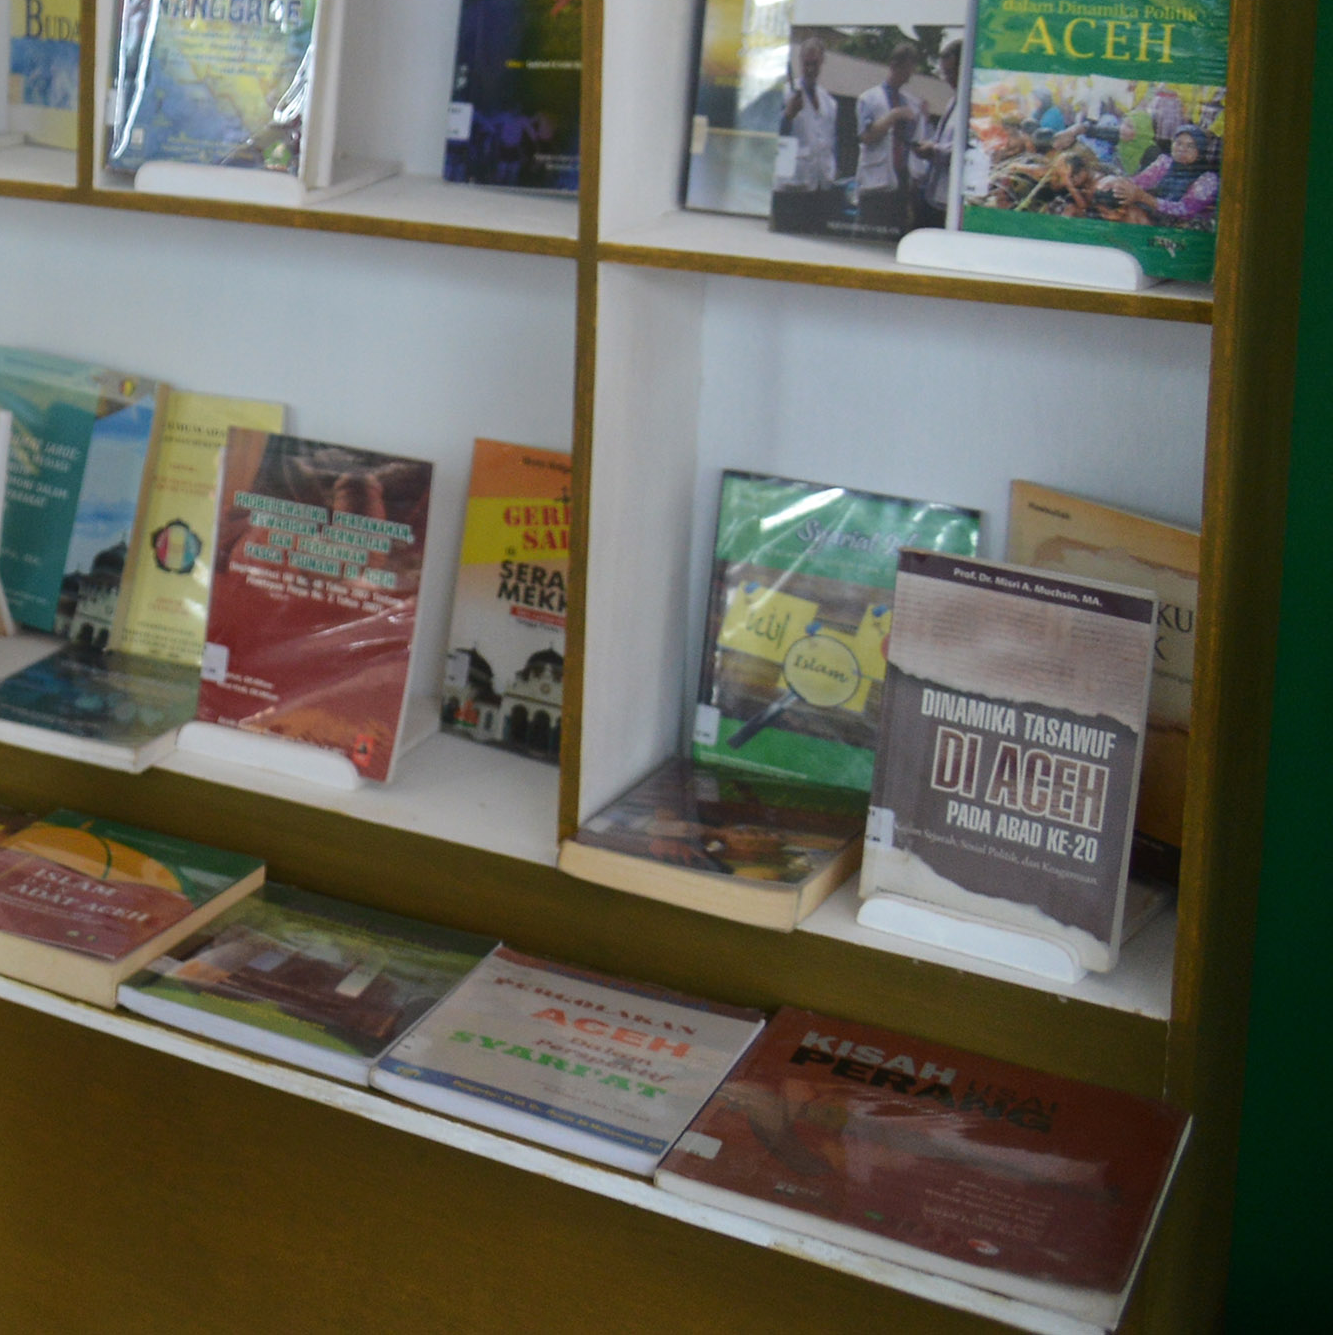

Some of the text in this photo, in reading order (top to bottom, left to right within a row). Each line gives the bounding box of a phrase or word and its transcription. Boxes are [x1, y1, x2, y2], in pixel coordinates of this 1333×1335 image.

[1058, 0, 1139, 18] Dinamika
[1144, 5, 1198, 23] Politik
[1020, 16, 1176, 64] ACEH
[245, 541, 284, 564] PASCA
[500, 560, 565, 591] SERA
[953, 567, 976, 581] Prof.
[978, 572, 994, 584] Dr.
[996, 575, 1021, 590] Misri
[1022, 581, 1033, 592] A.
[1082, 594, 1103, 607] MA.
[921, 687, 1116, 760] DINAMIKA TASAWUF
[930, 725, 1110, 833] DI ACEH
[946, 799, 1098, 865] PADA ABAD KE-20
[33, 868, 117, 897] ISLAM
[79, 901, 149, 922] ACEH
[530, 1006, 692, 1059] ACEH
[800, 1030, 958, 1085] KISAH
